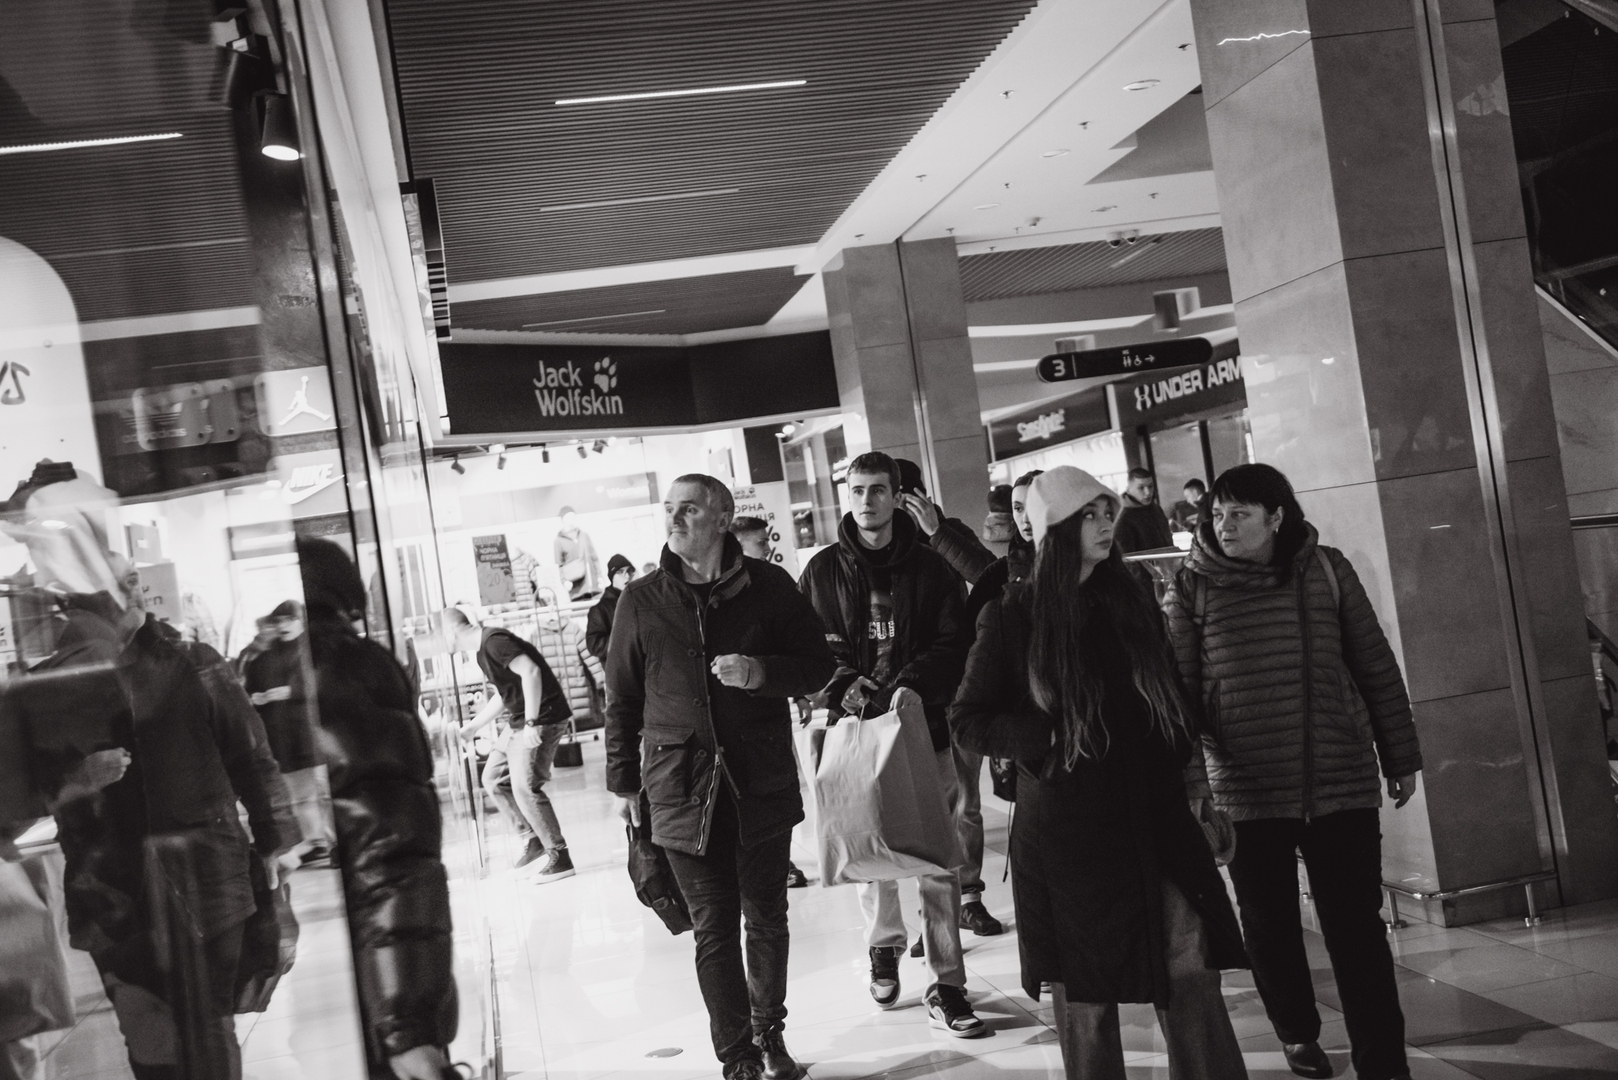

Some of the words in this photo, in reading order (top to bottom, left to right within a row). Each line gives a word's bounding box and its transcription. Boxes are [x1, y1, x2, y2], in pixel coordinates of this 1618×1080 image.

[533, 360, 583, 388] Jack
[1052, 359, 1066, 377] 3
[1152, 369, 1203, 404] UNDER
[1208, 355, 1243, 389] ARM
[535, 388, 623, 417] Wolfskin
[290, 463, 334, 489] NIKE
[734, 502, 765, 514] ОРНА
